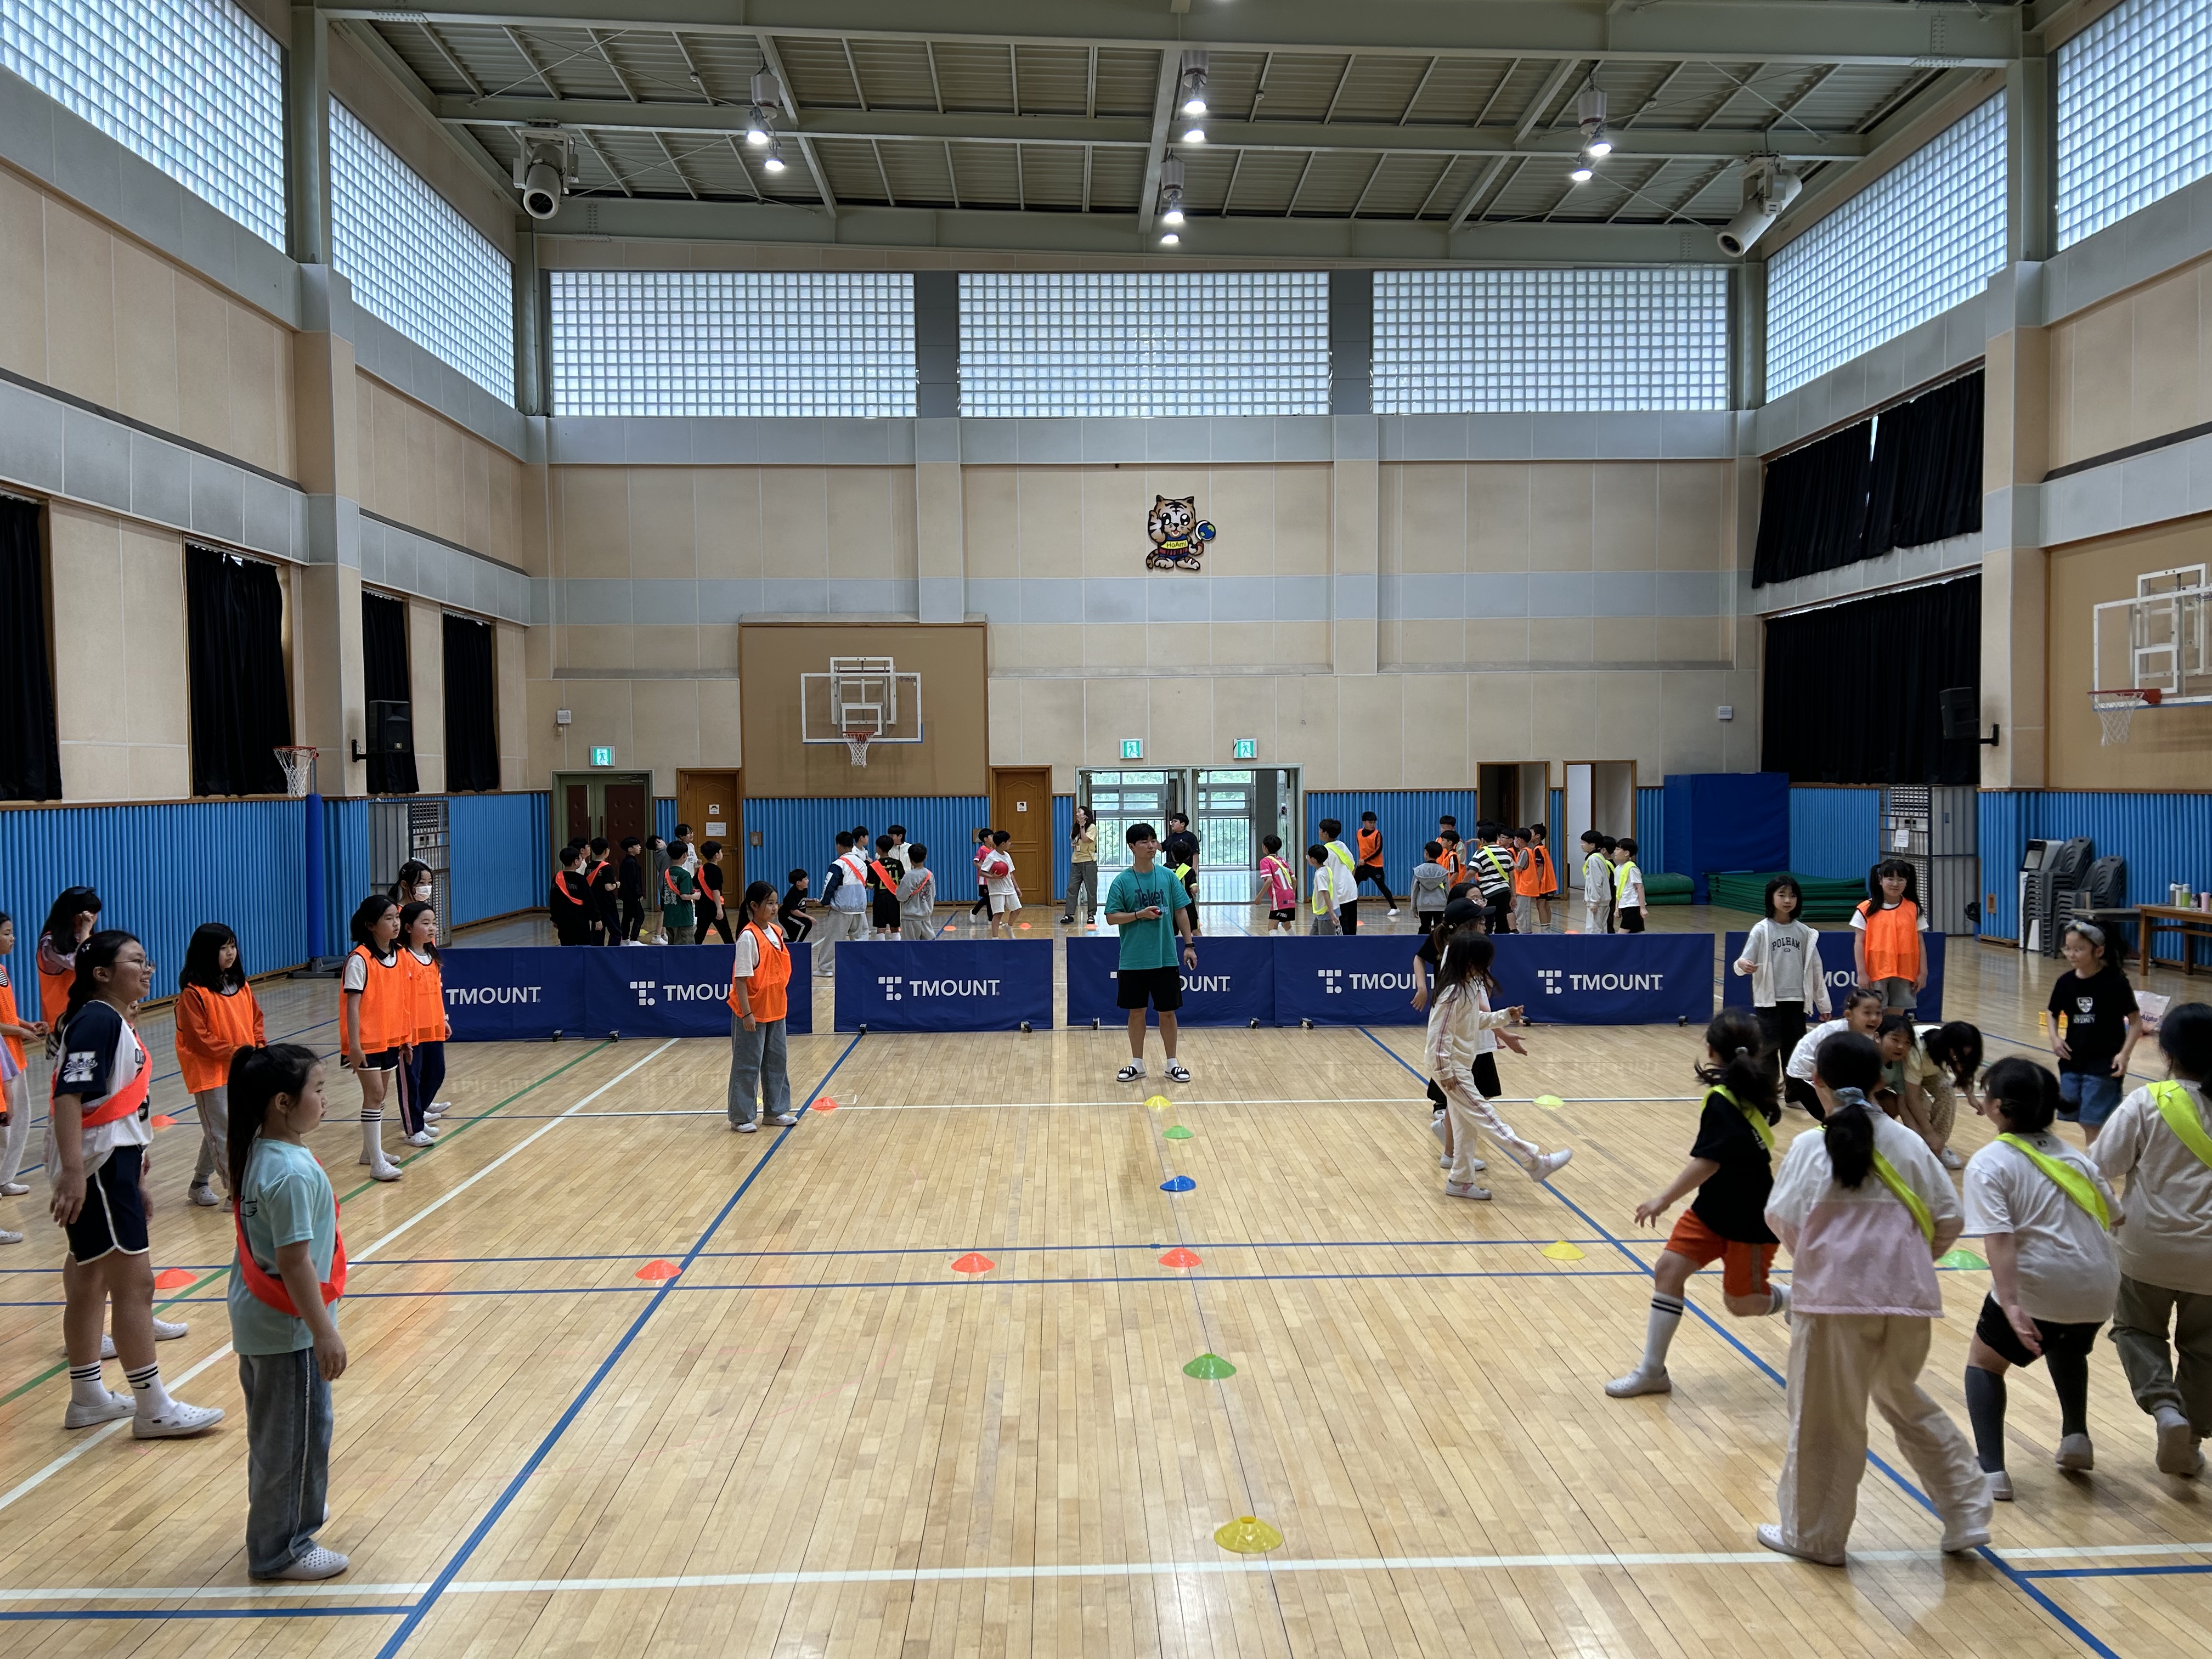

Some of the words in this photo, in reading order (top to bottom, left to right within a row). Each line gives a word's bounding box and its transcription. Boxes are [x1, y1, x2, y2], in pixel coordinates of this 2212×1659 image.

[1771, 936, 1801, 951] POLHAM
[909, 979, 1001, 997] TMOUNT
[1349, 973, 1435, 990] TMOUT
[1569, 973, 1663, 991] TMOUNT
[445, 986, 541, 1005] TMOUNT
[663, 984, 733, 1001] TMOU
